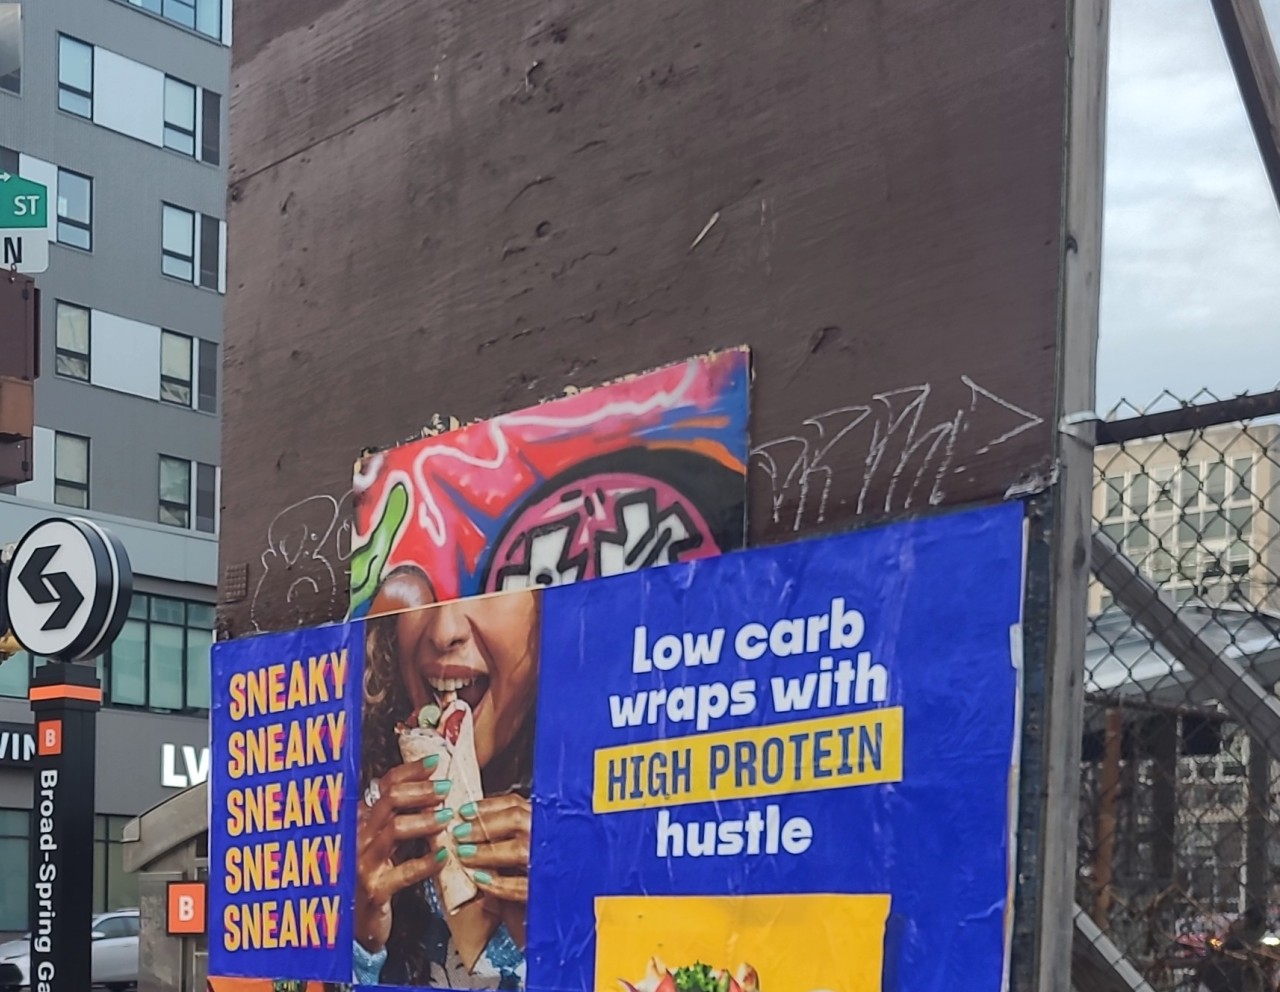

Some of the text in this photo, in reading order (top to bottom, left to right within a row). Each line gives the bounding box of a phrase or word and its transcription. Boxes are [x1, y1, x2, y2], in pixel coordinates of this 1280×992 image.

[14, 196, 40, 216] ST
[4, 237, 22, 264] N
[632, 597, 865, 674] Low carb
[229, 649, 348, 722] SNEAKY
[609, 651, 888, 731] wraps with
[45, 729, 56, 748] B
[228, 711, 346, 779] SNEAKY
[607, 722, 883, 802] HIGH PROTEIN
[226, 773, 344, 837] SNEAKY
[656, 804, 813, 858] hustle
[35, 770, 58, 952] Broad-Spring
[225, 834, 342, 895] SNEAKY
[179, 895, 195, 922] B
[223, 896, 340, 952] SNEAKY
